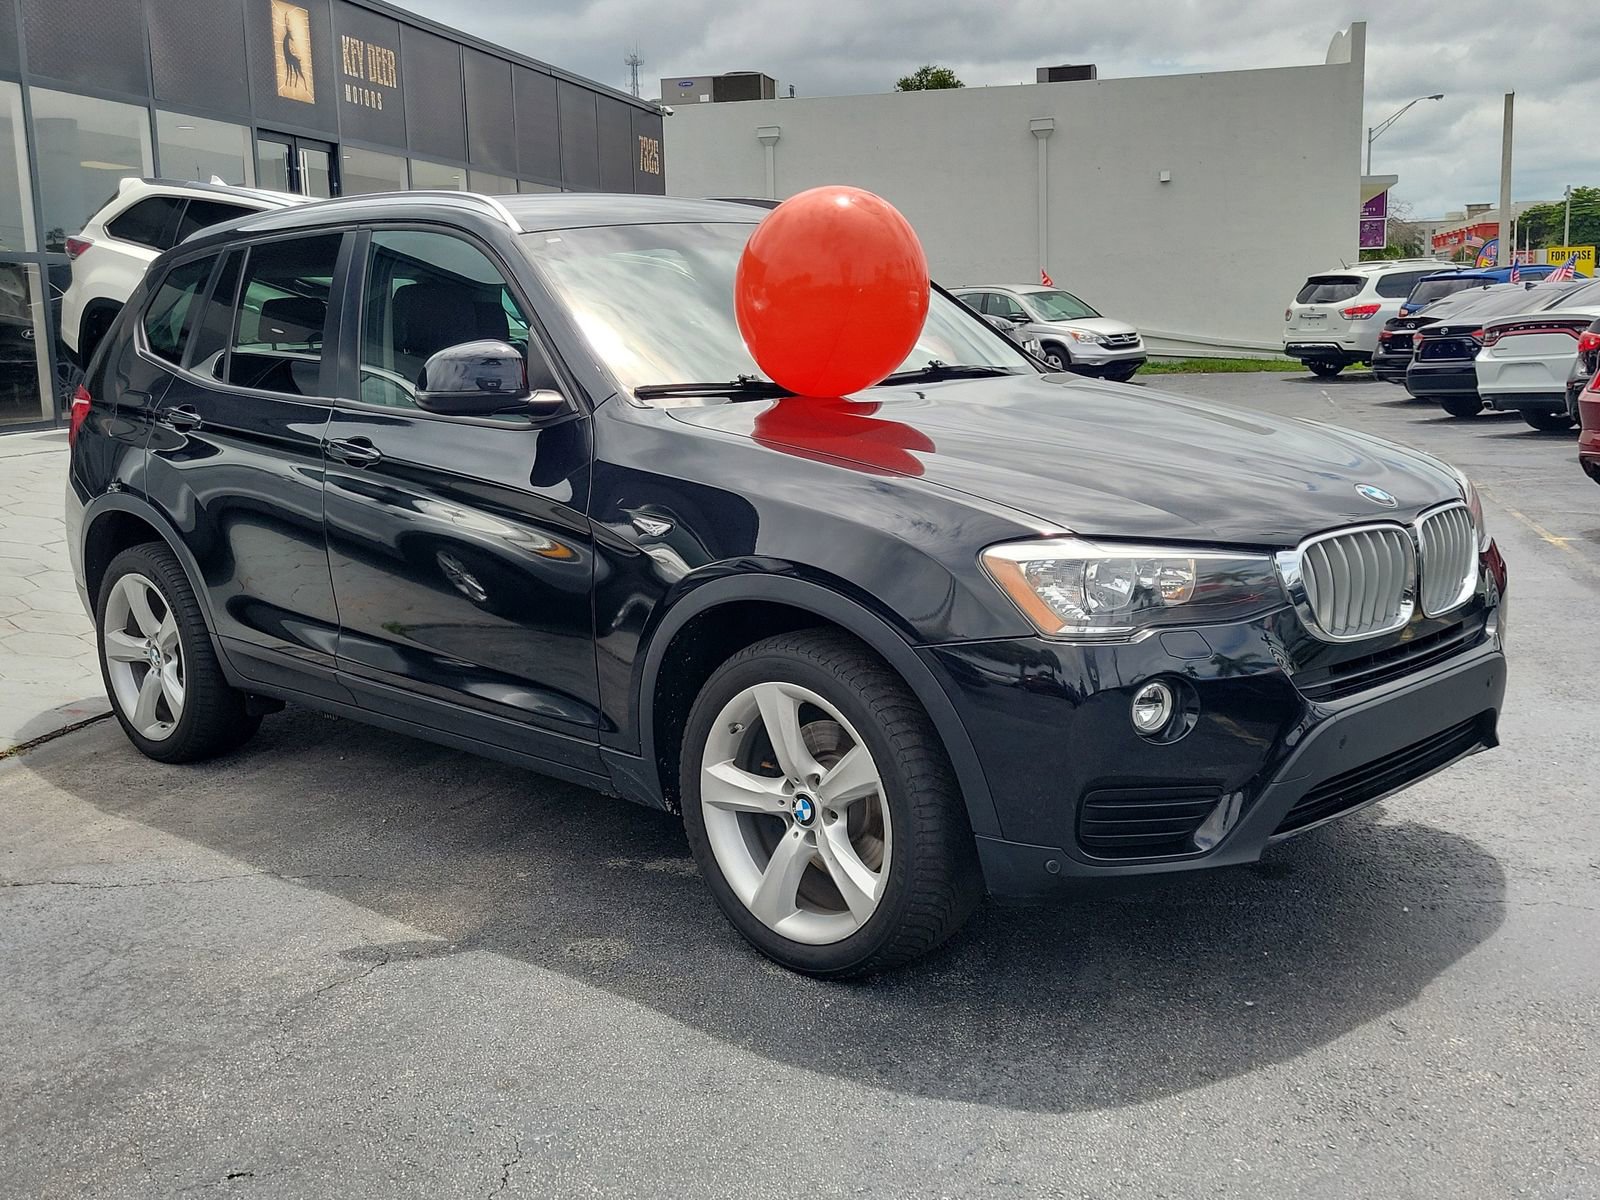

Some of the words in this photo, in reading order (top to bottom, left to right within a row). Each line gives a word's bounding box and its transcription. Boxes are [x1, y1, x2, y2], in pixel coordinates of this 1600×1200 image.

[341, 34, 364, 80] KEY
[366, 43, 397, 89] DEER
[344, 83, 383, 111] MOTORS
[1551, 250, 1566, 261] FOR
